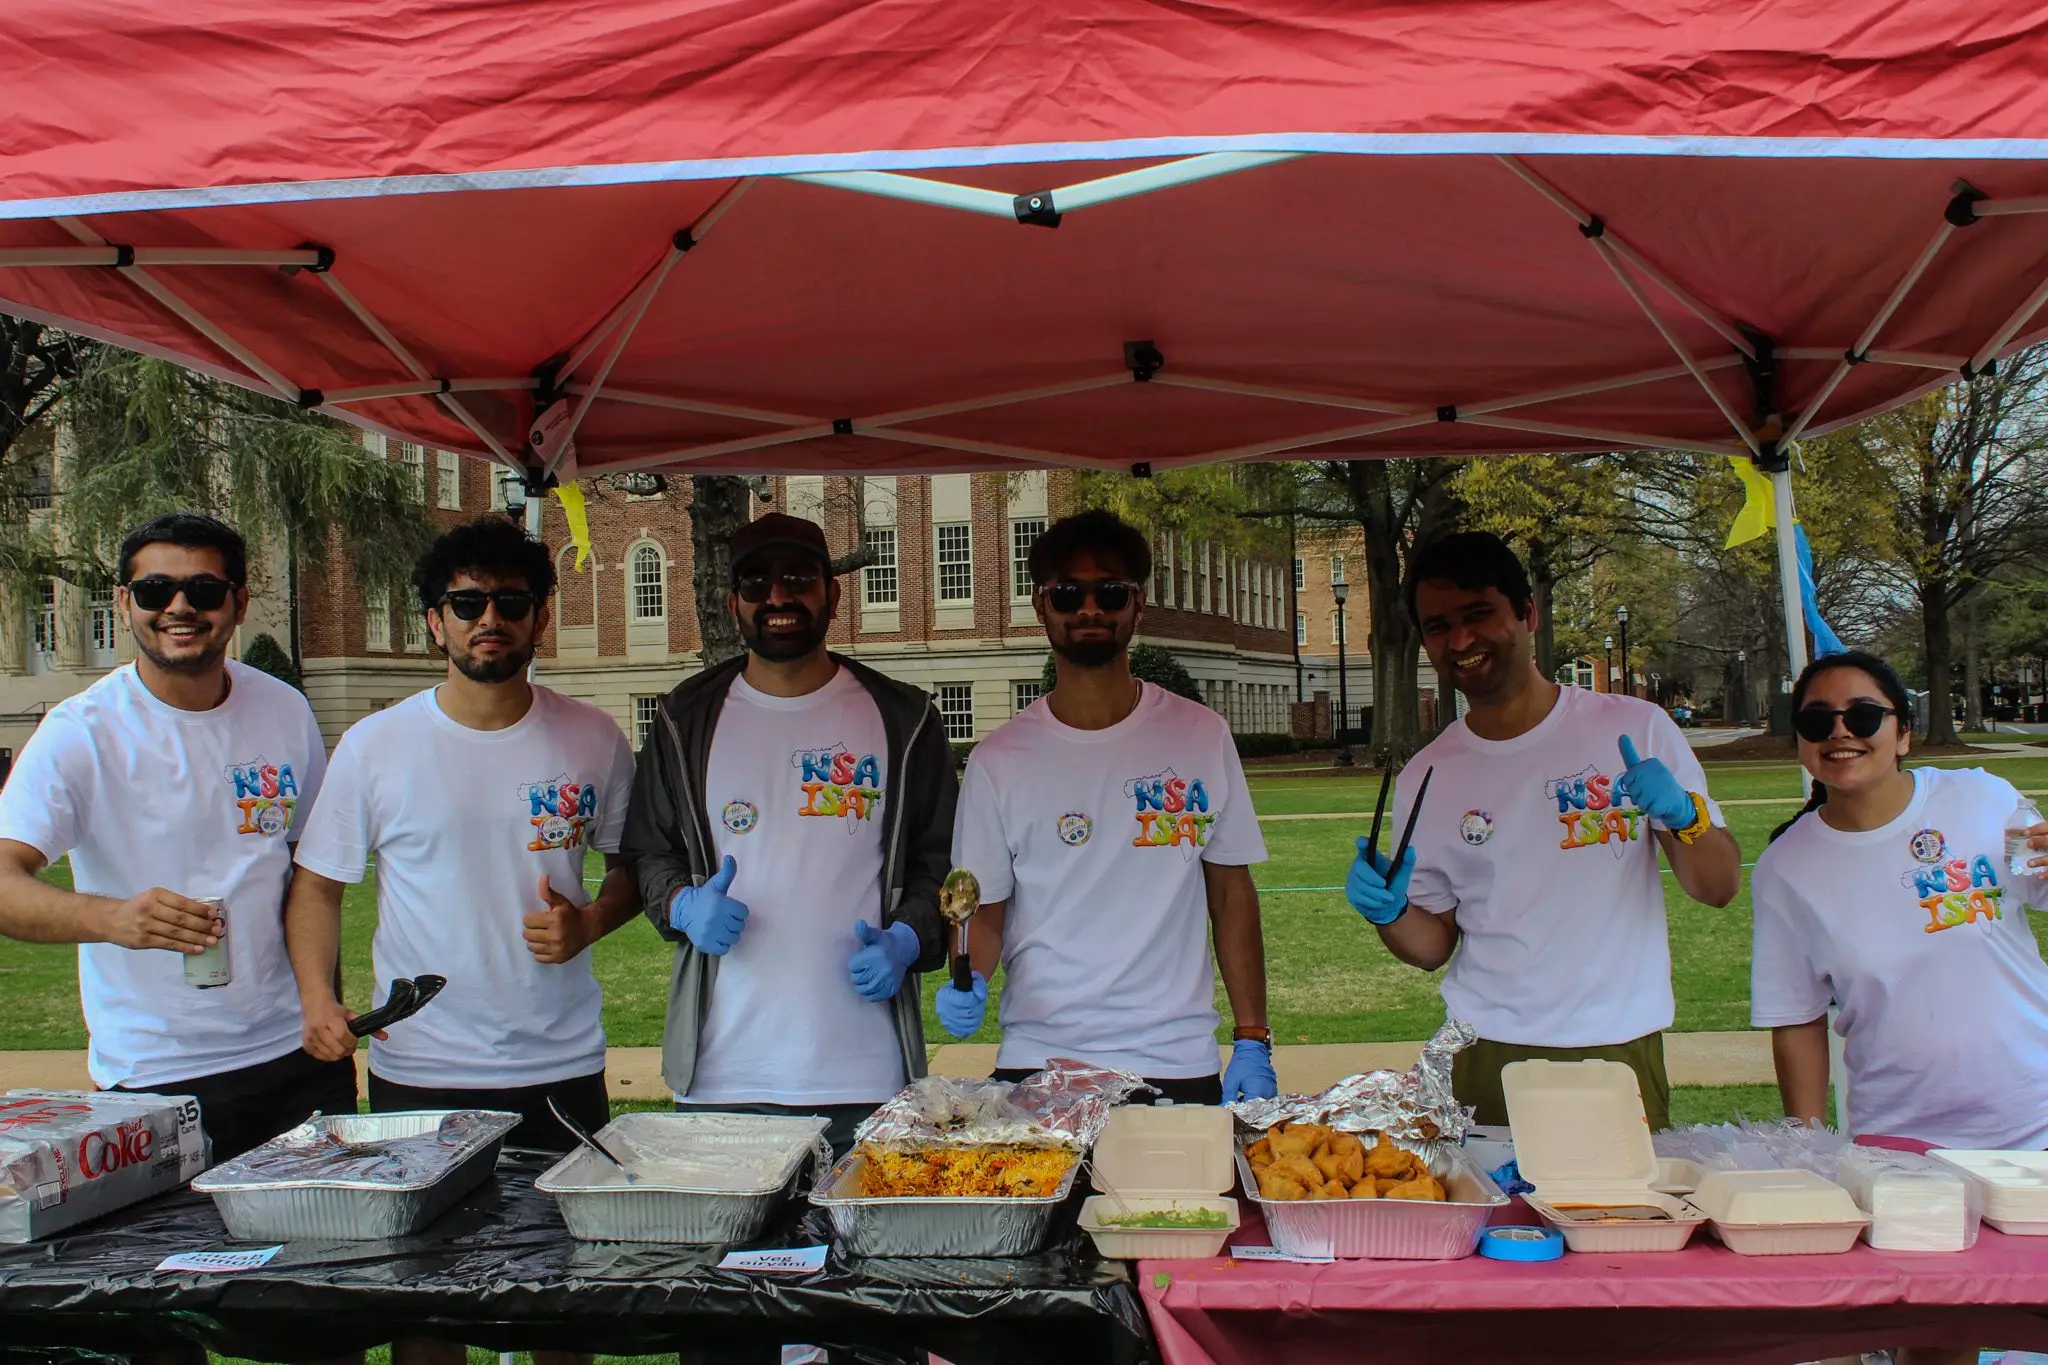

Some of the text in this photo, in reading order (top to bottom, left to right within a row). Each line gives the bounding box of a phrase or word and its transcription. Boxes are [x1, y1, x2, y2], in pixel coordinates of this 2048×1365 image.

[232, 763, 298, 798] NSA
[802, 752, 880, 788] NSA
[529, 784, 597, 818] NSA
[798, 783, 882, 822] ISAT
[1134, 778, 1209, 814] NSA
[1132, 811, 1215, 848] ISAT
[1559, 807, 1648, 850] ISAT
[1911, 854, 1998, 899] NSA
[1919, 887, 2004, 934] ISAT
[176, 1101, 199, 1125] 35
[79, 1126, 154, 1180] Coke
